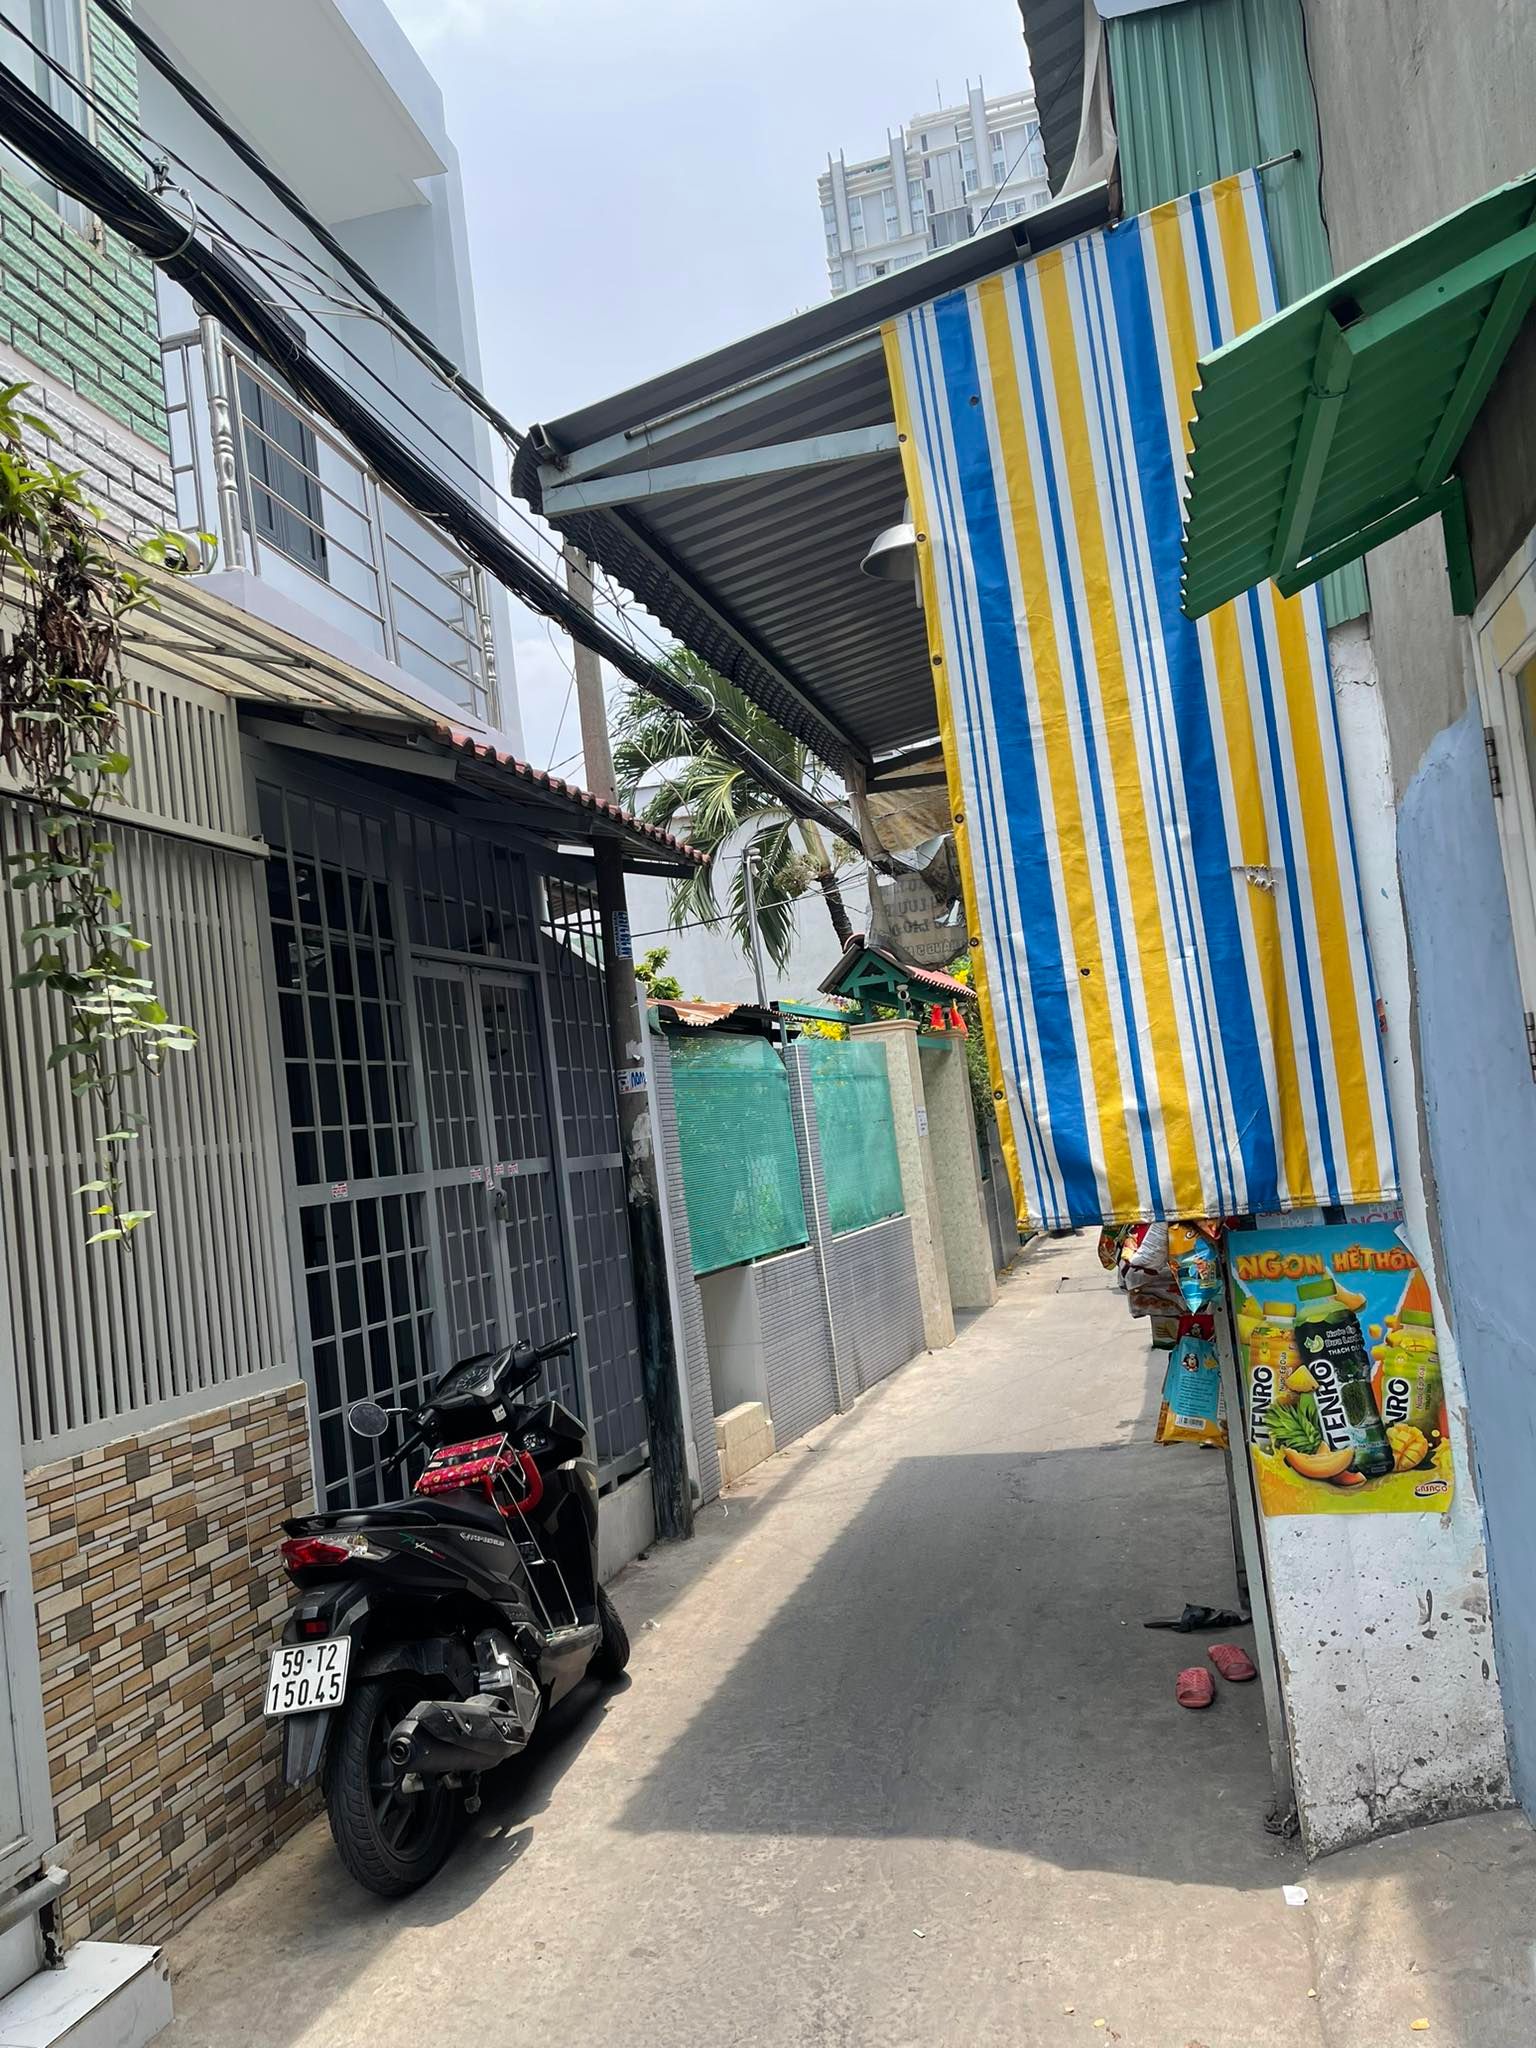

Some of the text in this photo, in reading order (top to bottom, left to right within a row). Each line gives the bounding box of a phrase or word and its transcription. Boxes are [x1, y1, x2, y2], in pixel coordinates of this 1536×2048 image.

[1236, 1250, 1324, 1280] NGON
[1310, 1360, 1351, 1452] TENRO
[281, 1643, 338, 1678] 59-T2
[272, 1672, 341, 1711] 150.45
